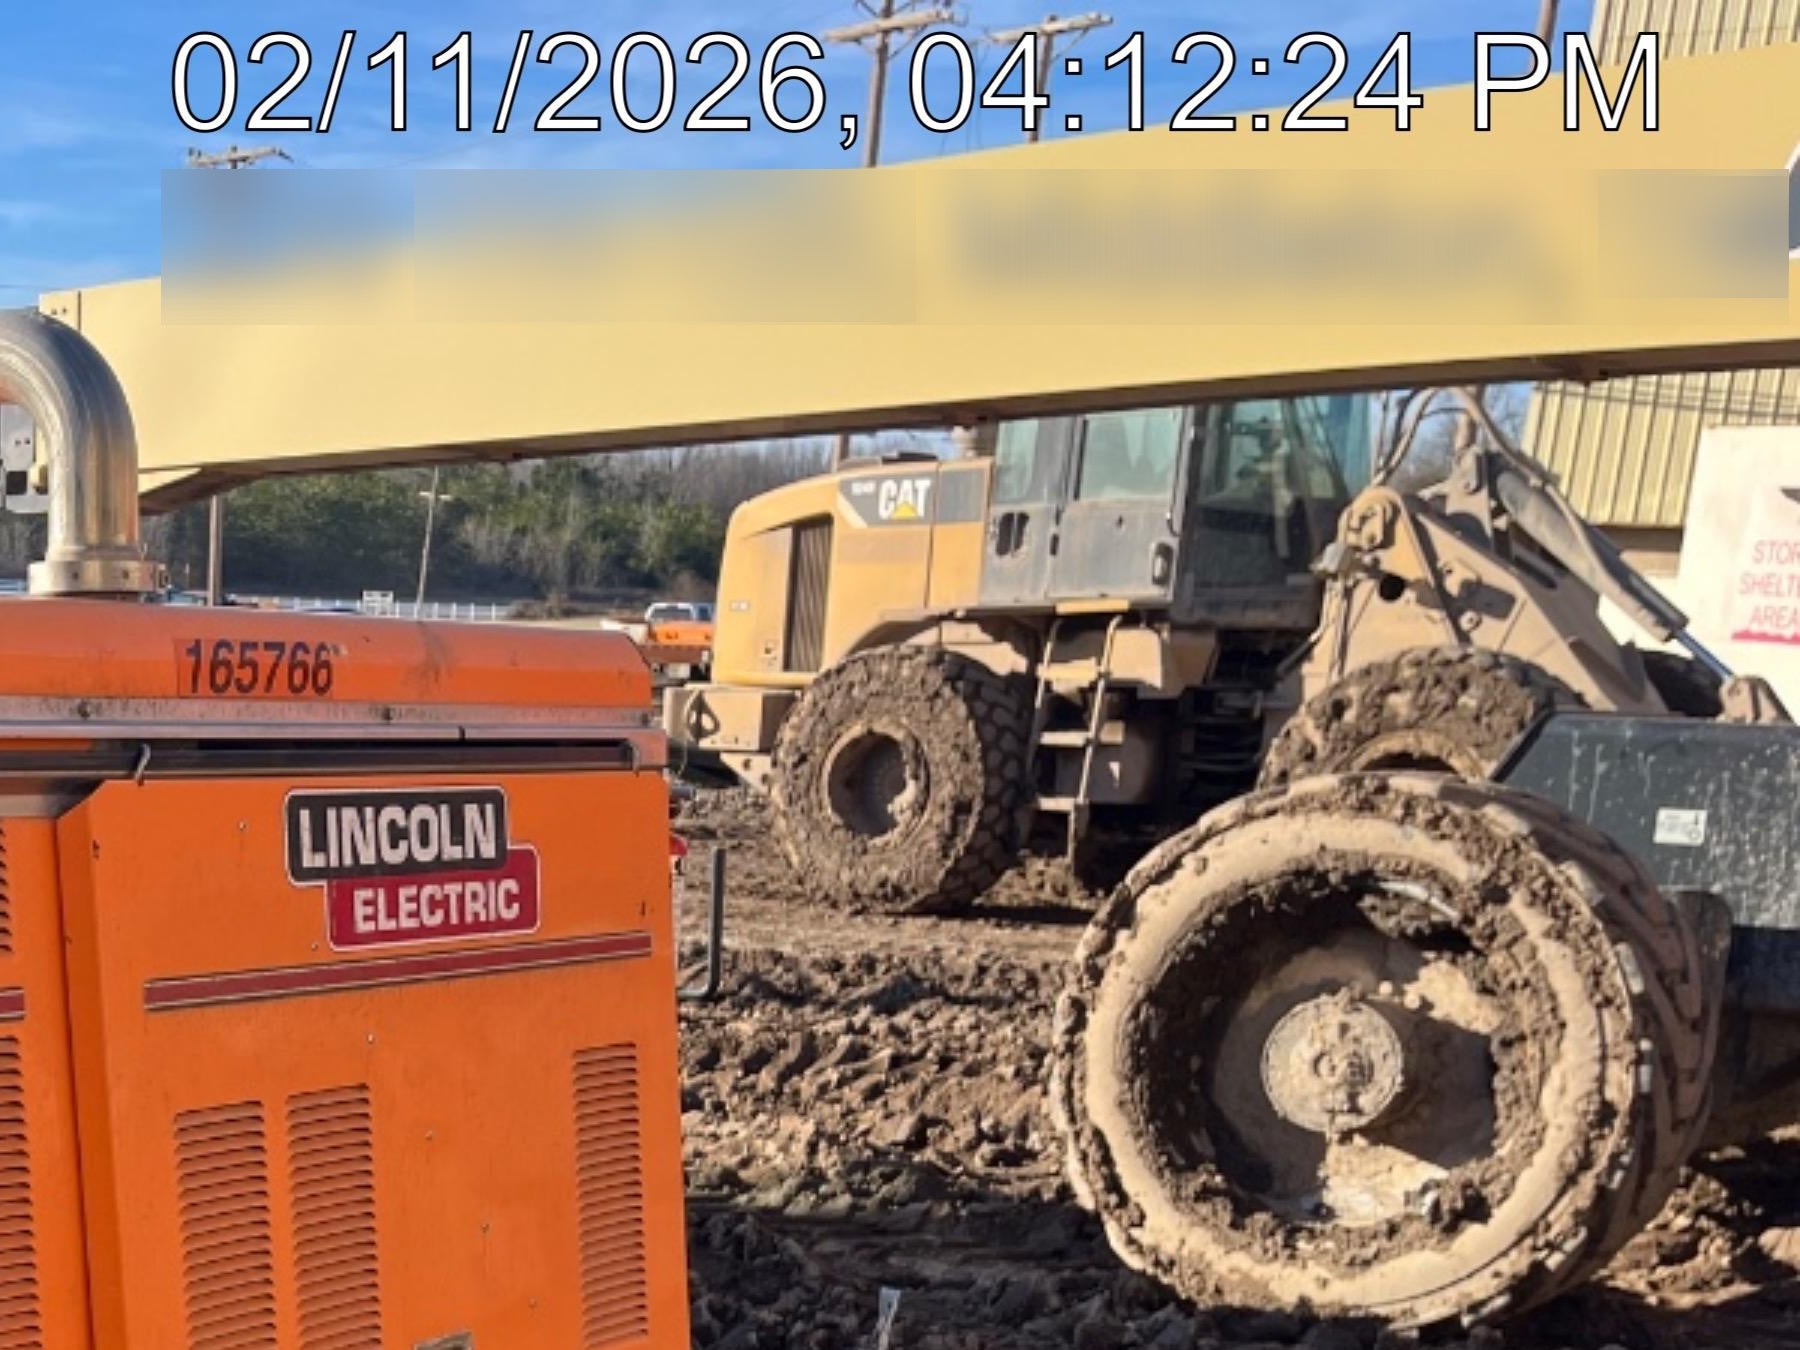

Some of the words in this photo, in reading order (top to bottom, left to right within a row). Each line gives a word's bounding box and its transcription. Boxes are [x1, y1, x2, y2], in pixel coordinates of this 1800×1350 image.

[878, 478, 932, 520] CAT
[184, 639, 334, 697] 165766
[298, 802, 497, 869] LINCOLN
[352, 878, 521, 934] ELECTRIC
